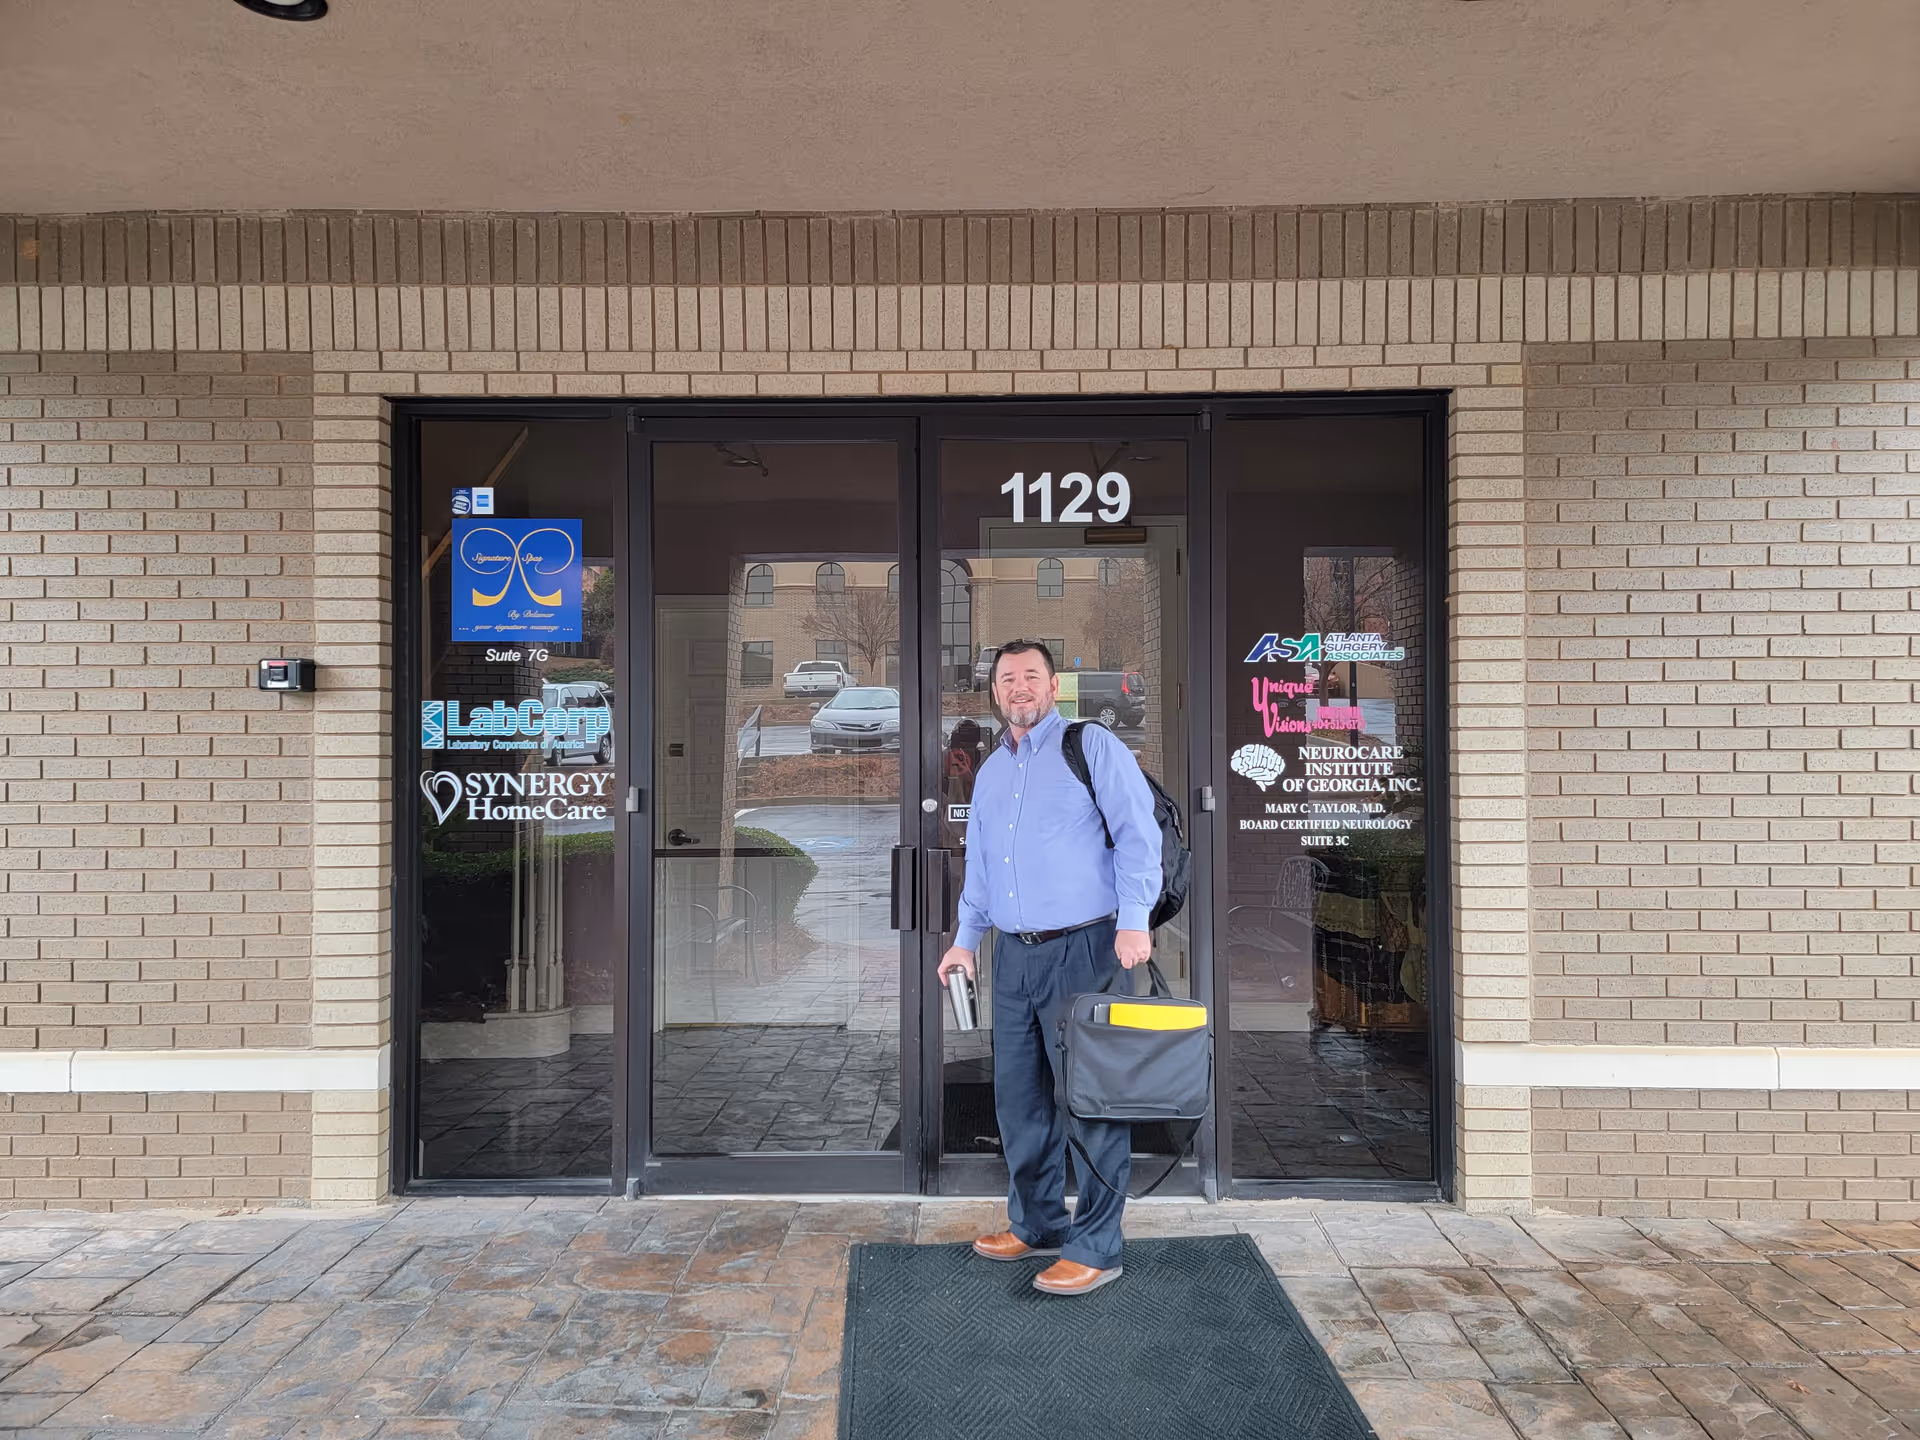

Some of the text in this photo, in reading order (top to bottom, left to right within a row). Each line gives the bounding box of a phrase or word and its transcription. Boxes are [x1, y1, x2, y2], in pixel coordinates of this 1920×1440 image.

[1001, 471, 1131, 523] 1129
[472, 552, 512, 564] Signature
[507, 609, 520, 620] By
[494, 624, 528, 632] signature
[1325, 633, 1382, 642] ATLANTA
[1325, 642, 1386, 651] SURGERY
[485, 648, 549, 662] Suite 7G
[1325, 651, 1405, 661] ASSOCIATES
[1251, 677, 1313, 711] Unique
[446, 699, 611, 743] LabCorp
[1263, 702, 1312, 737] Visions
[447, 739, 585, 751] Laboratory Corporation of America
[1298, 746, 1404, 760] NEUROCARE
[1305, 762, 1394, 776] INSTITUTE
[1282, 778, 1421, 794] OF GEORGIA, INC.
[466, 797, 607, 820] HomeCare
[953, 808, 965, 817] NO
[1265, 803, 1386, 815] MARY C. TAYLOR, M.D.
[1240, 820, 1413, 830] BOARD CERTIFIED NEUROLOGY
[1301, 836, 1350, 846] SUITE 3C
